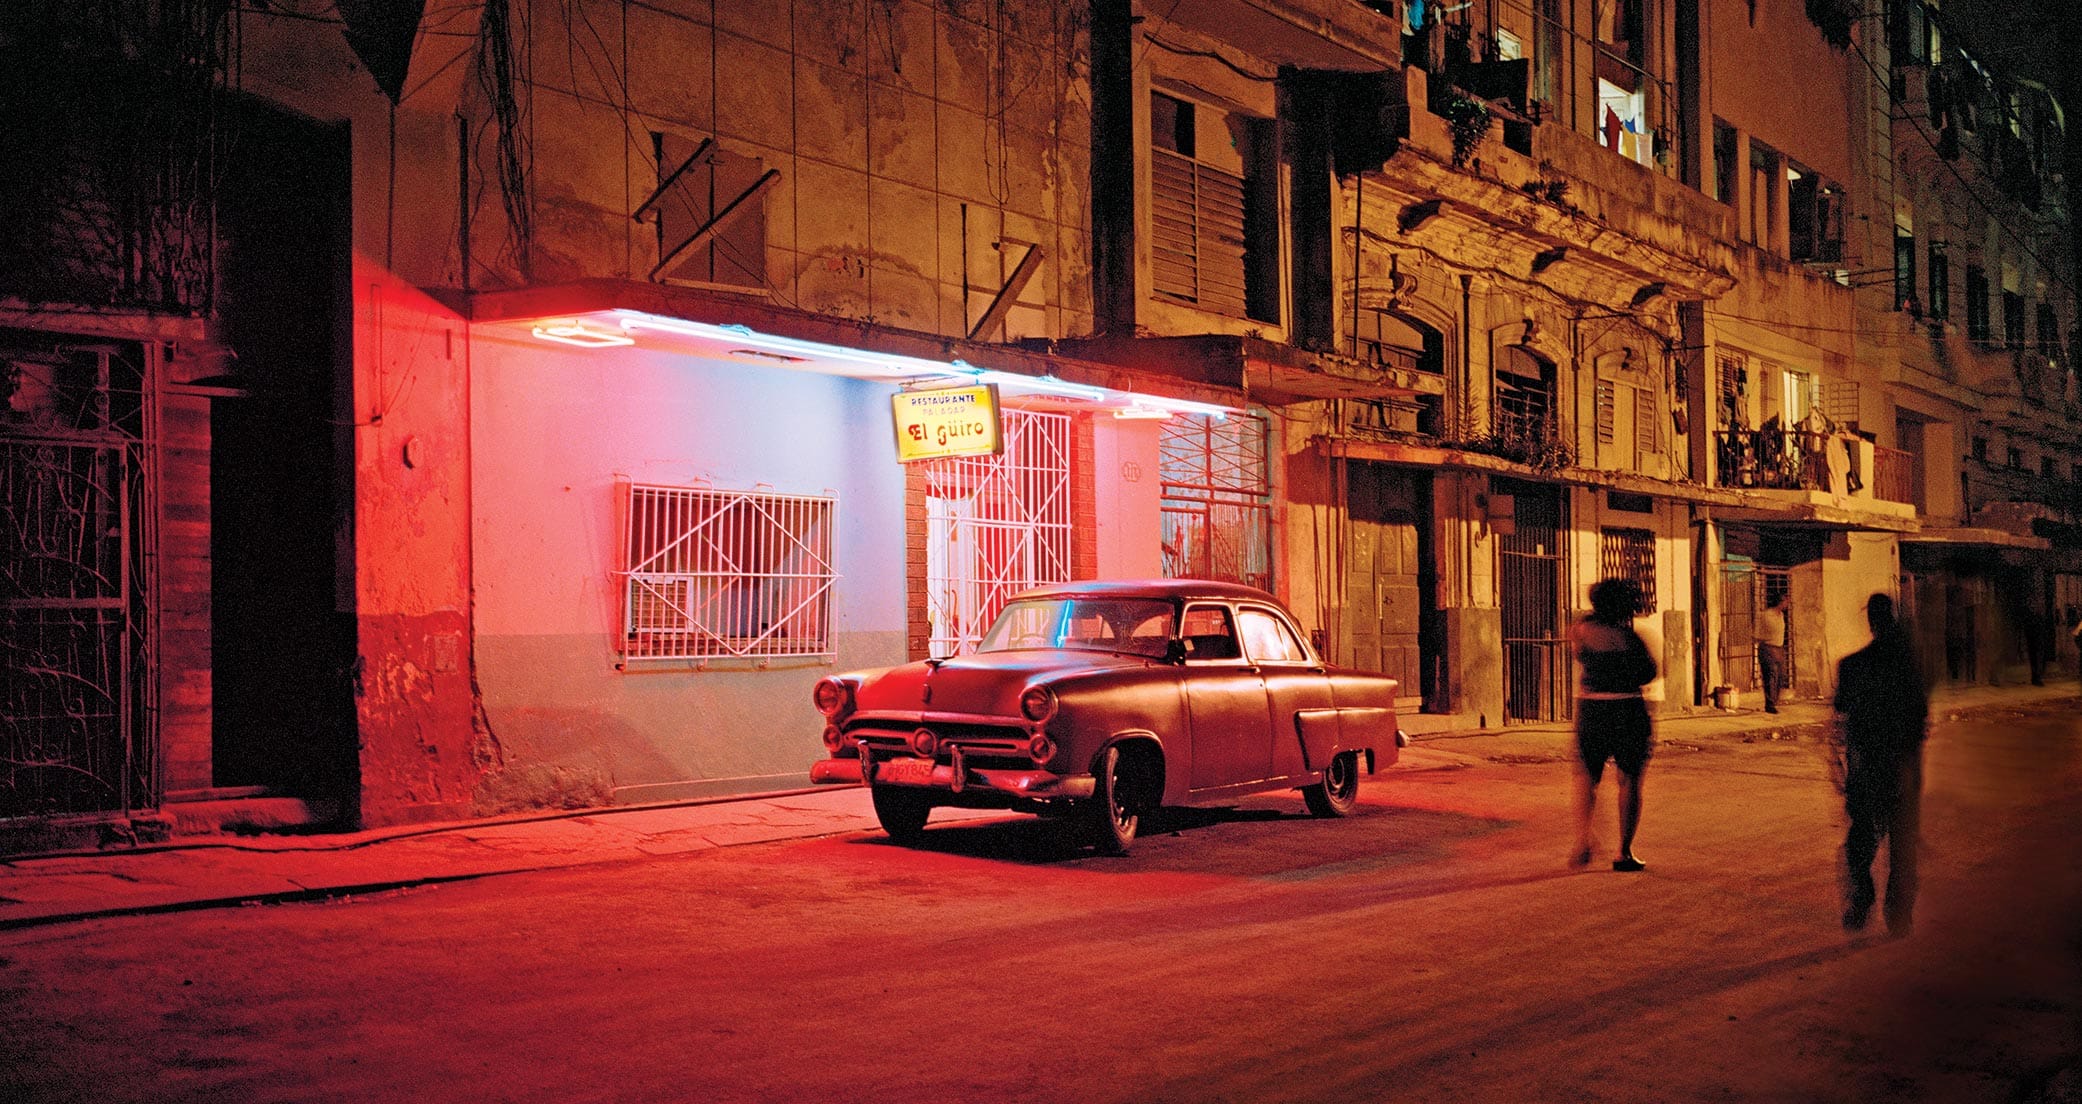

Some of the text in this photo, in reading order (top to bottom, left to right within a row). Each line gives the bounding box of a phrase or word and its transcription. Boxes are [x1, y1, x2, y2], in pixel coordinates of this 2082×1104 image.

[911, 394, 975, 406] RESTAURANTE
[908, 420, 984, 446] El güiro
